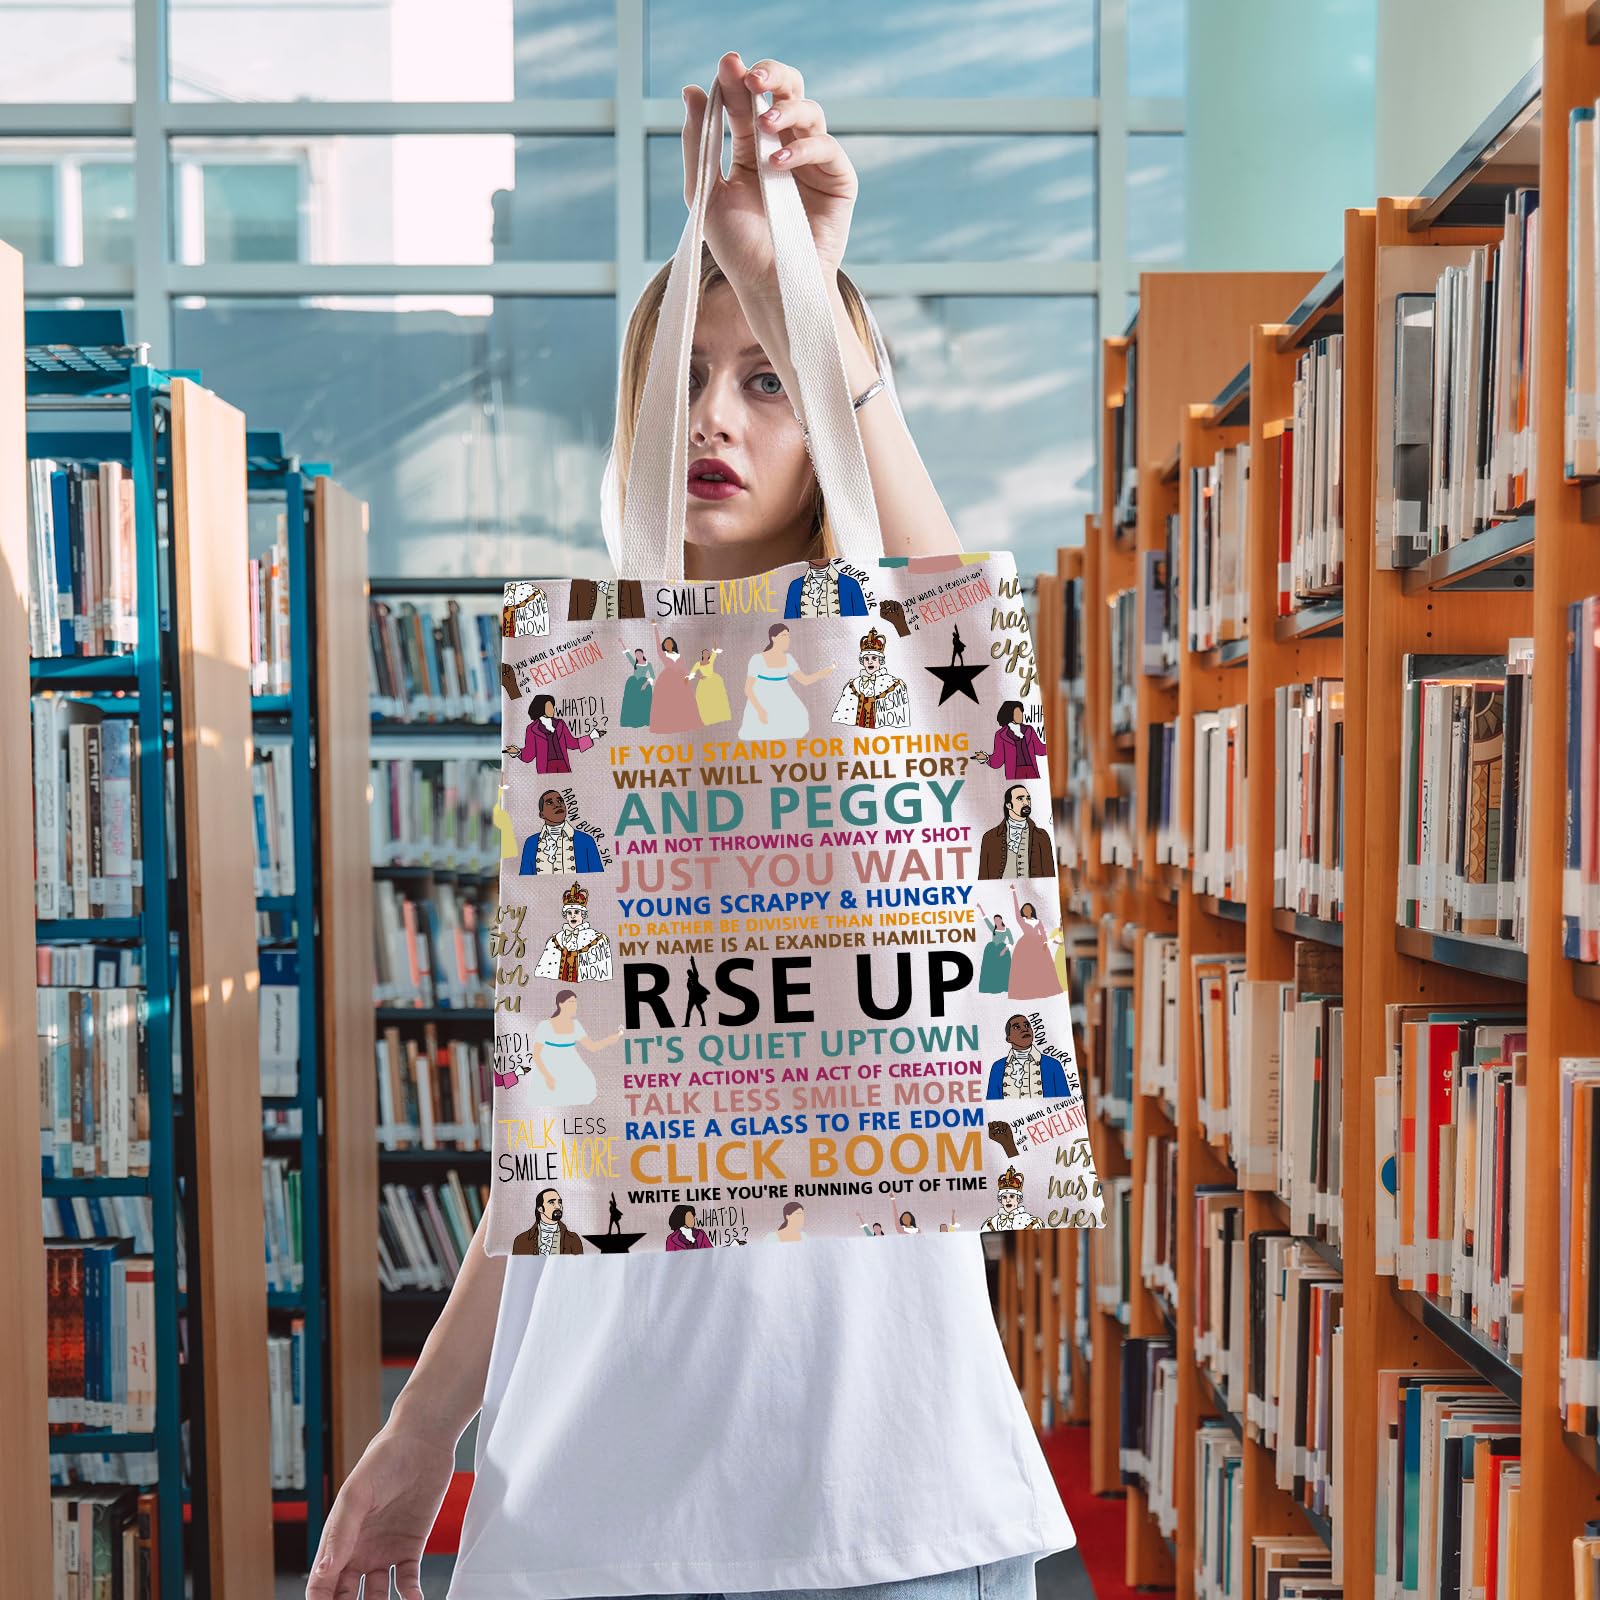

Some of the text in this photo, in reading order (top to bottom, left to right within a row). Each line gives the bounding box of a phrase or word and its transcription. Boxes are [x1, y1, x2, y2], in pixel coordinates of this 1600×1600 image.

[657, 572, 778, 617] SMILE MORE
[865, 592, 877, 610] SIR
[902, 597, 916, 613] you
[919, 578, 992, 625] REVELATION
[517, 617, 545, 635] WOW
[513, 659, 528, 676] you
[529, 640, 604, 687] REVELATION
[990, 639, 1034, 673] eye
[556, 696, 605, 717] WHAT'D I
[877, 707, 906, 726] WOW
[568, 716, 609, 736] MISS?
[610, 731, 970, 767] IF YOU STAND FOR NOTHING
[613, 757, 968, 789] WHAT WILL YOU FALL FOR?
[615, 780, 964, 836] AND PEGGY
[561, 788, 580, 821] AARON
[600, 848, 613, 867] SIR
[615, 827, 970, 855] I AM NOT THROWING AWAY MY SHOT
[618, 848, 970, 892] JUST YOU WAIT
[618, 885, 973, 919] YOUNG SCRAPPY & HUNGRY
[618, 909, 975, 939] I'D RATHER BE DIVISIVE THAN INDECISIVE
[620, 941, 649, 956] MY
[657, 938, 714, 954] NAME
[721, 938, 737, 953] IS
[873, 928, 975, 946] HAMILTON
[579, 962, 609, 980] WOW
[624, 951, 973, 1029] RSE UP
[526, 1033, 530, 1047] I
[625, 1025, 978, 1066] IT'S QUIET UPTOWN
[1028, 1012, 1047, 1046] AARON
[1066, 1072, 1080, 1091] SIR
[624, 1061, 982, 1089] EVERY ACTION'S AN ACT OF CREATION
[625, 1080, 982, 1117] TALK LESS SMILE MORE
[498, 1117, 607, 1149] TALK LESS
[625, 1120, 696, 1140] RAISE
[704, 1119, 722, 1137] A
[730, 1114, 808, 1136] GLASS
[816, 1113, 850, 1133] TO
[1010, 1117, 1024, 1134] you
[499, 1137, 620, 1182] SMILE MORE
[629, 1130, 983, 1185] CLICK BOOM
[628, 1177, 987, 1203] WRITE LIKE YOU'RE RUNNING OUT OF TIME
[1048, 1175, 1087, 1200] has
[695, 1206, 745, 1228] WHAT'D I
[708, 1227, 749, 1247] MISS?
